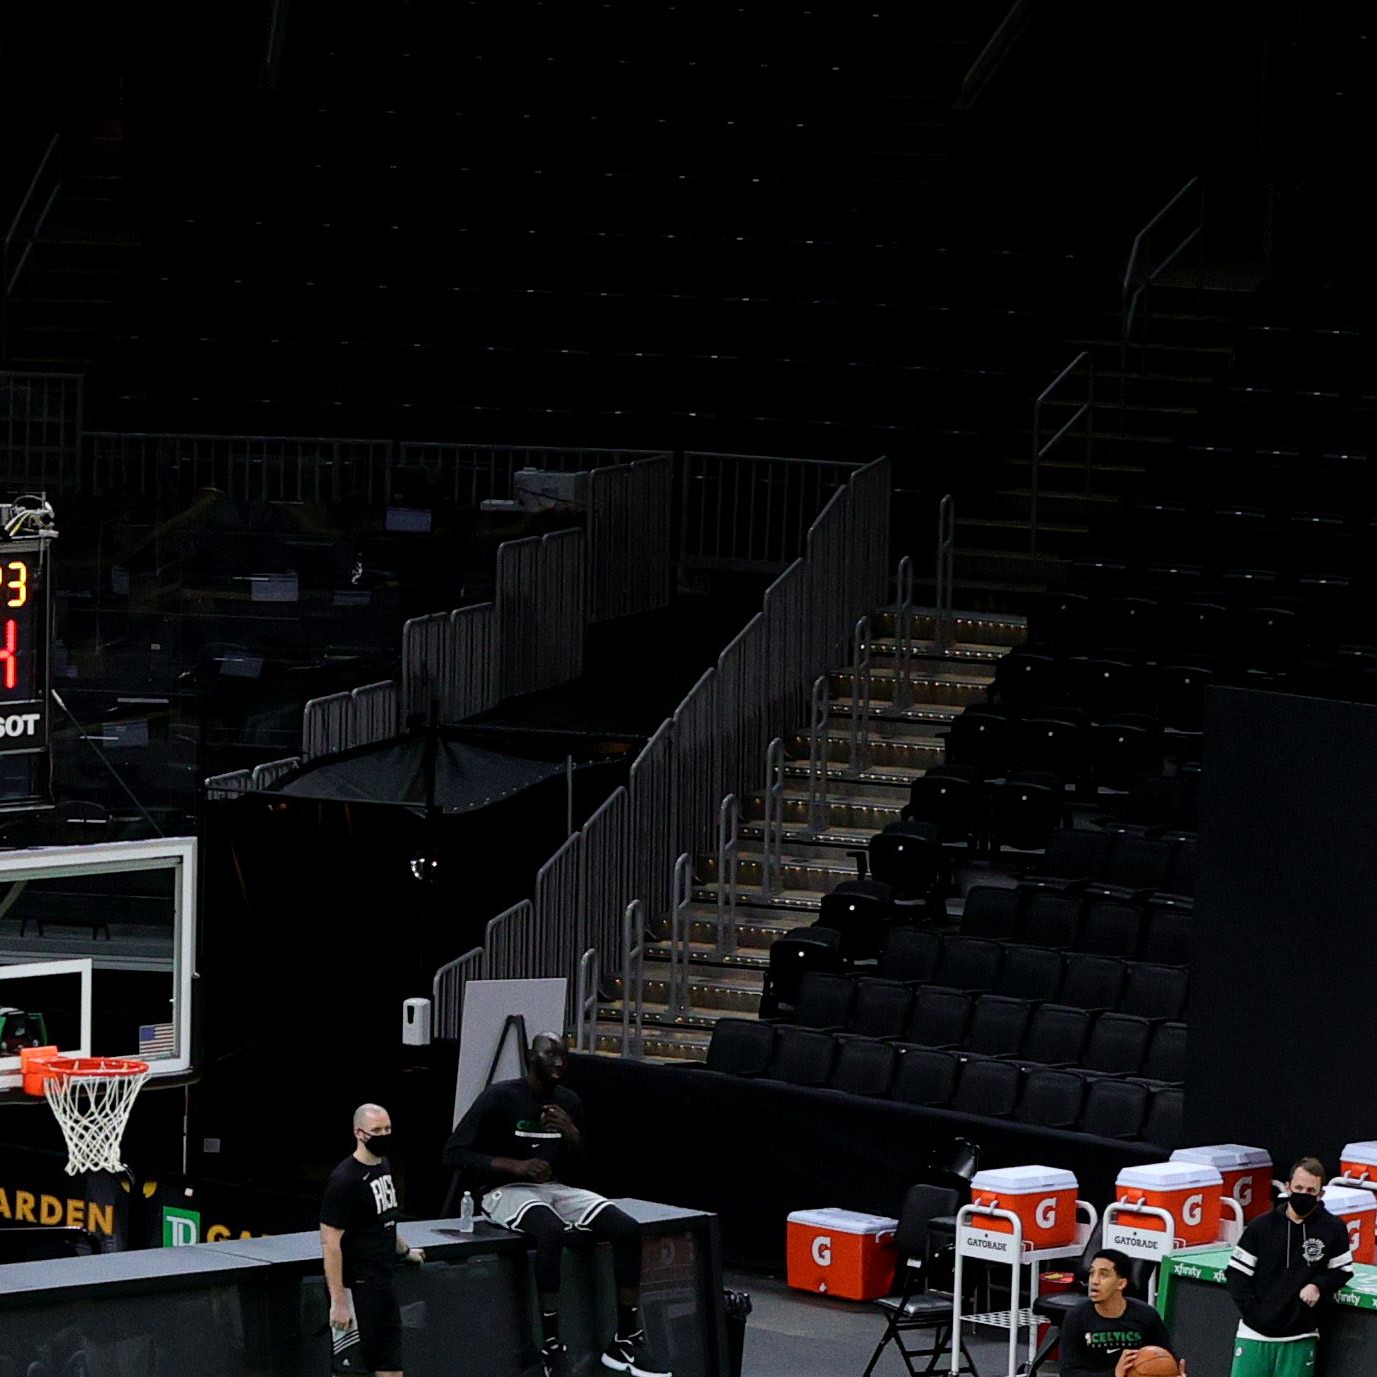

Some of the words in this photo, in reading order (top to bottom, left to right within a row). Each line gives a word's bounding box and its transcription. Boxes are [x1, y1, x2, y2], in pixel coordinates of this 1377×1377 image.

[1233, 1176, 1253, 1206] G
[1035, 1197, 1057, 1229] G
[1182, 1194, 1203, 1226] G
[811, 1236, 831, 1267] G
[967, 1237, 1007, 1252] GATORADE
[1114, 1235, 1158, 1250] GATORADE
[1174, 1262, 1202, 1280] xfinity
[1092, 1331, 1142, 1343] CELTICS
